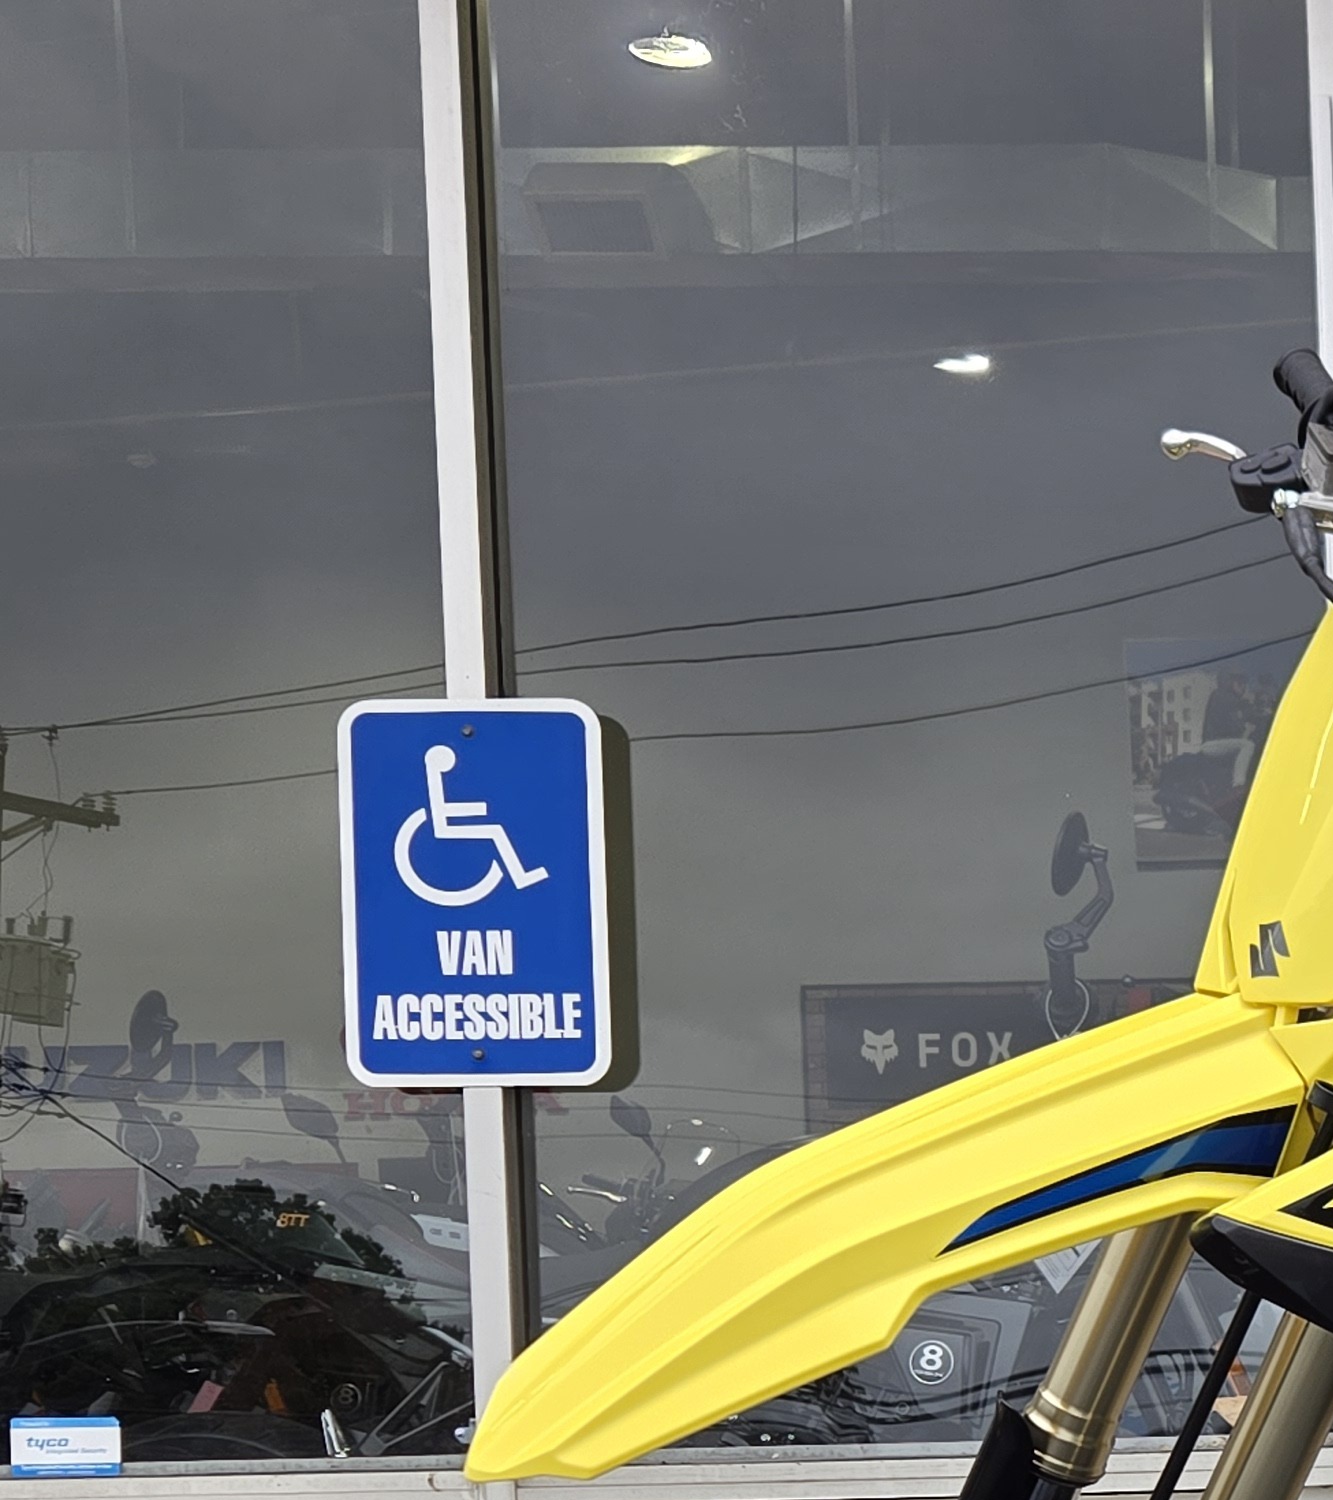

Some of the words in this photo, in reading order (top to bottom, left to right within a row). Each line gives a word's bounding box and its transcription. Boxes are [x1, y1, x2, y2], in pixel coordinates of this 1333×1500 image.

[436, 930, 513, 976] VAN
[372, 993, 582, 1041] ACCESSIBLE
[918, 1031, 1013, 1068] FOX
[920, 1344, 943, 1371] 8
[26, 1437, 70, 1450] tyco
